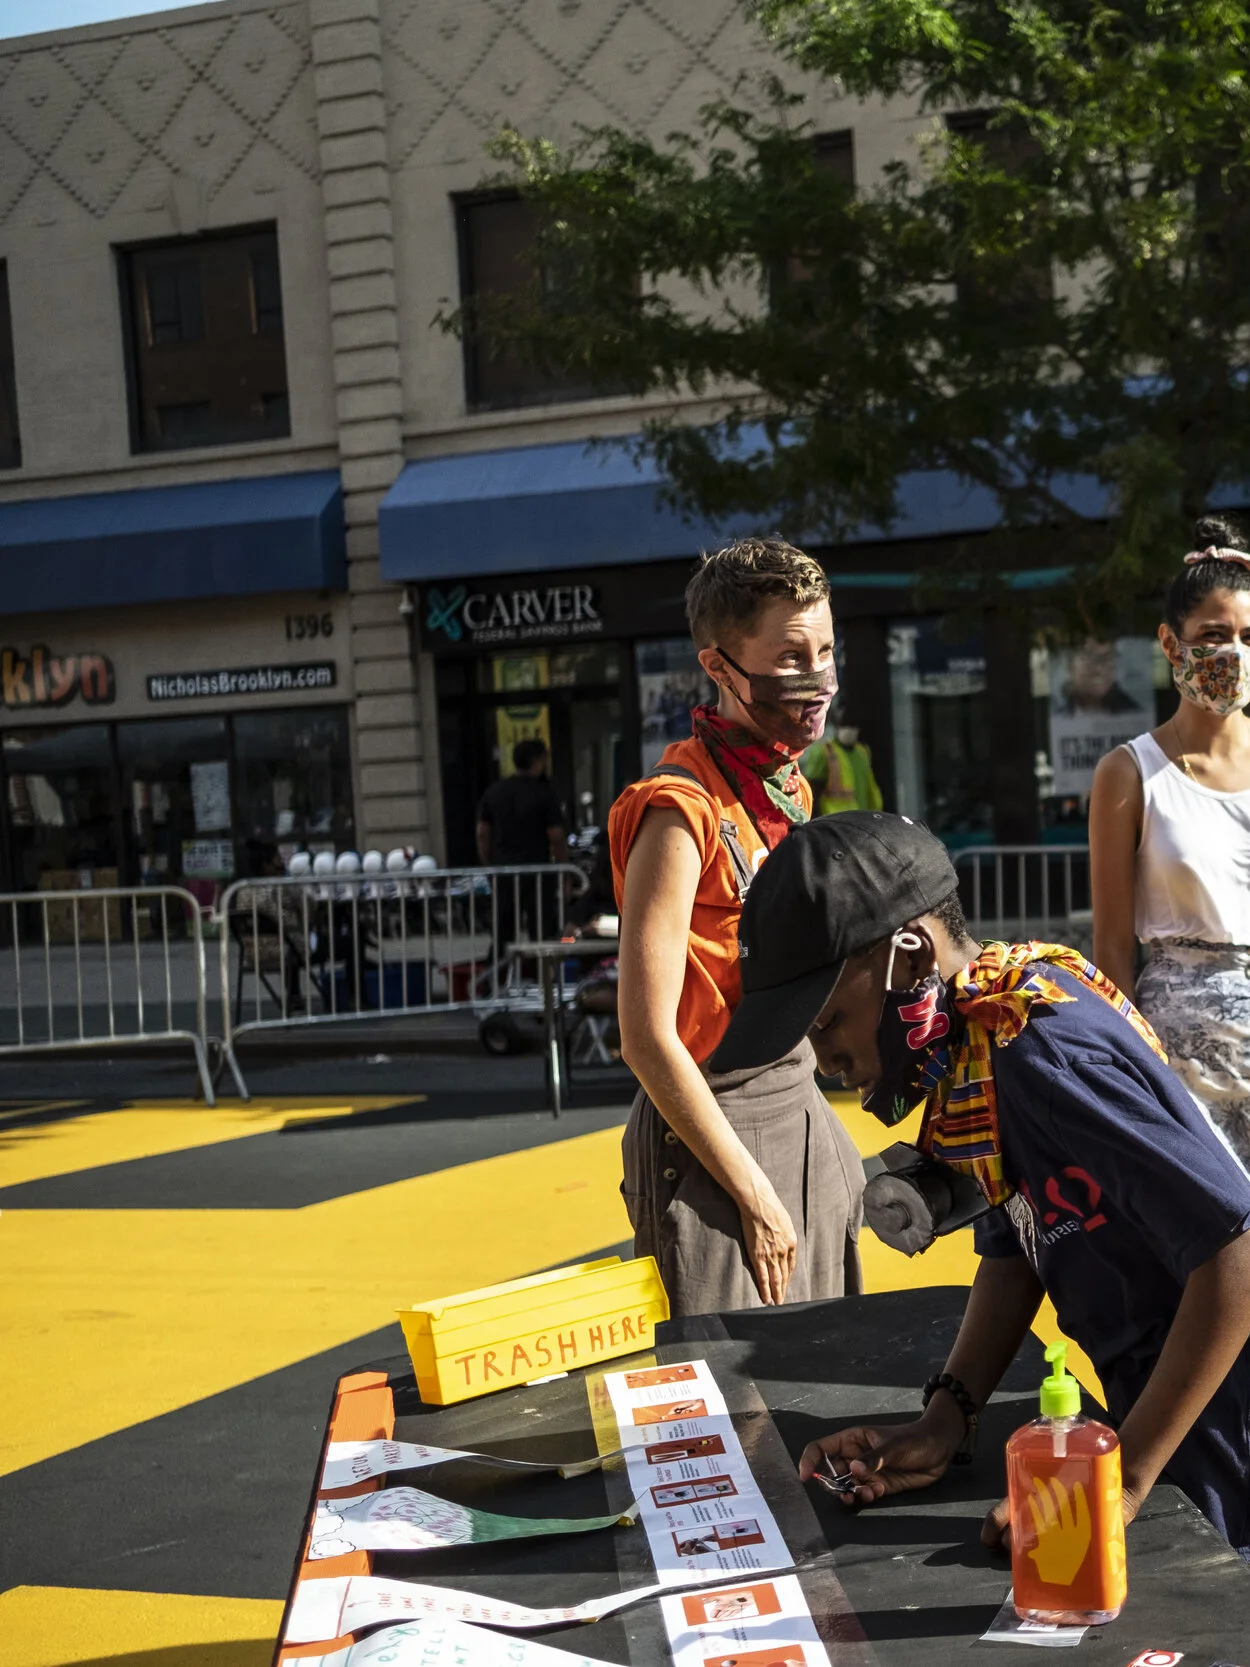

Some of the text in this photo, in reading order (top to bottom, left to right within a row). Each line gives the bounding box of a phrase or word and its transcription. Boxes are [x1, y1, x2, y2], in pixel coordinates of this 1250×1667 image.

[463, 585, 598, 630] CARVER
[284, 613, 334, 641] 1396
[472, 618, 604, 643] FEDERAL SAVINGS BANK
[150, 666, 332, 699] NicholasBrooklyn.com
[454, 1312, 648, 1386] TRASH HERE
